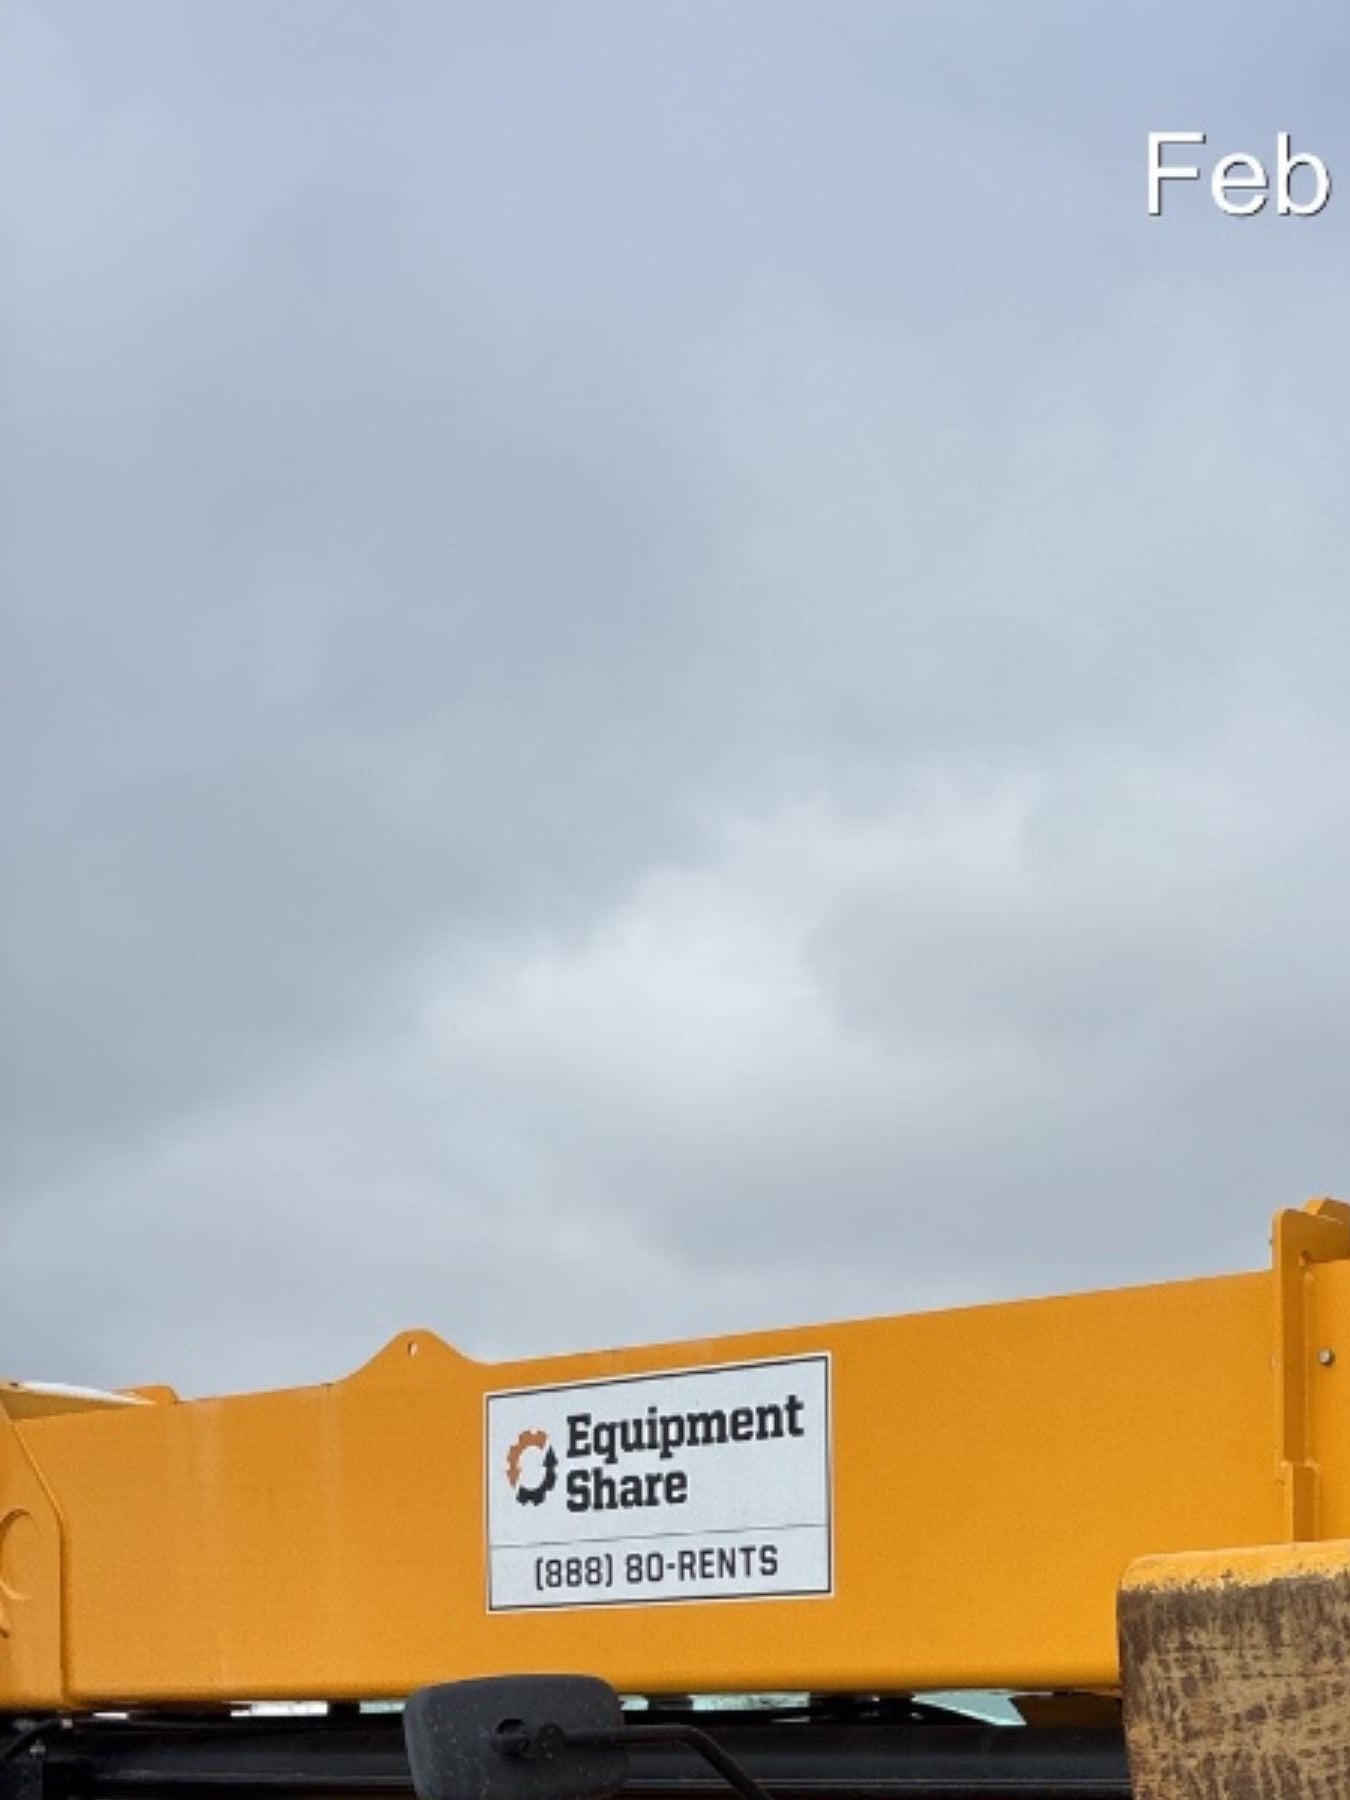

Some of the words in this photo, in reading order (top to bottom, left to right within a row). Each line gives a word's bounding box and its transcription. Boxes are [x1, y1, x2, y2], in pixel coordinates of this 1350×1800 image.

[565, 1394, 805, 1465] Equipment
[565, 1468, 689, 1513] Share
[535, 1552, 614, 1590] (888)
[625, 1544, 779, 1584] 80-RENTS
